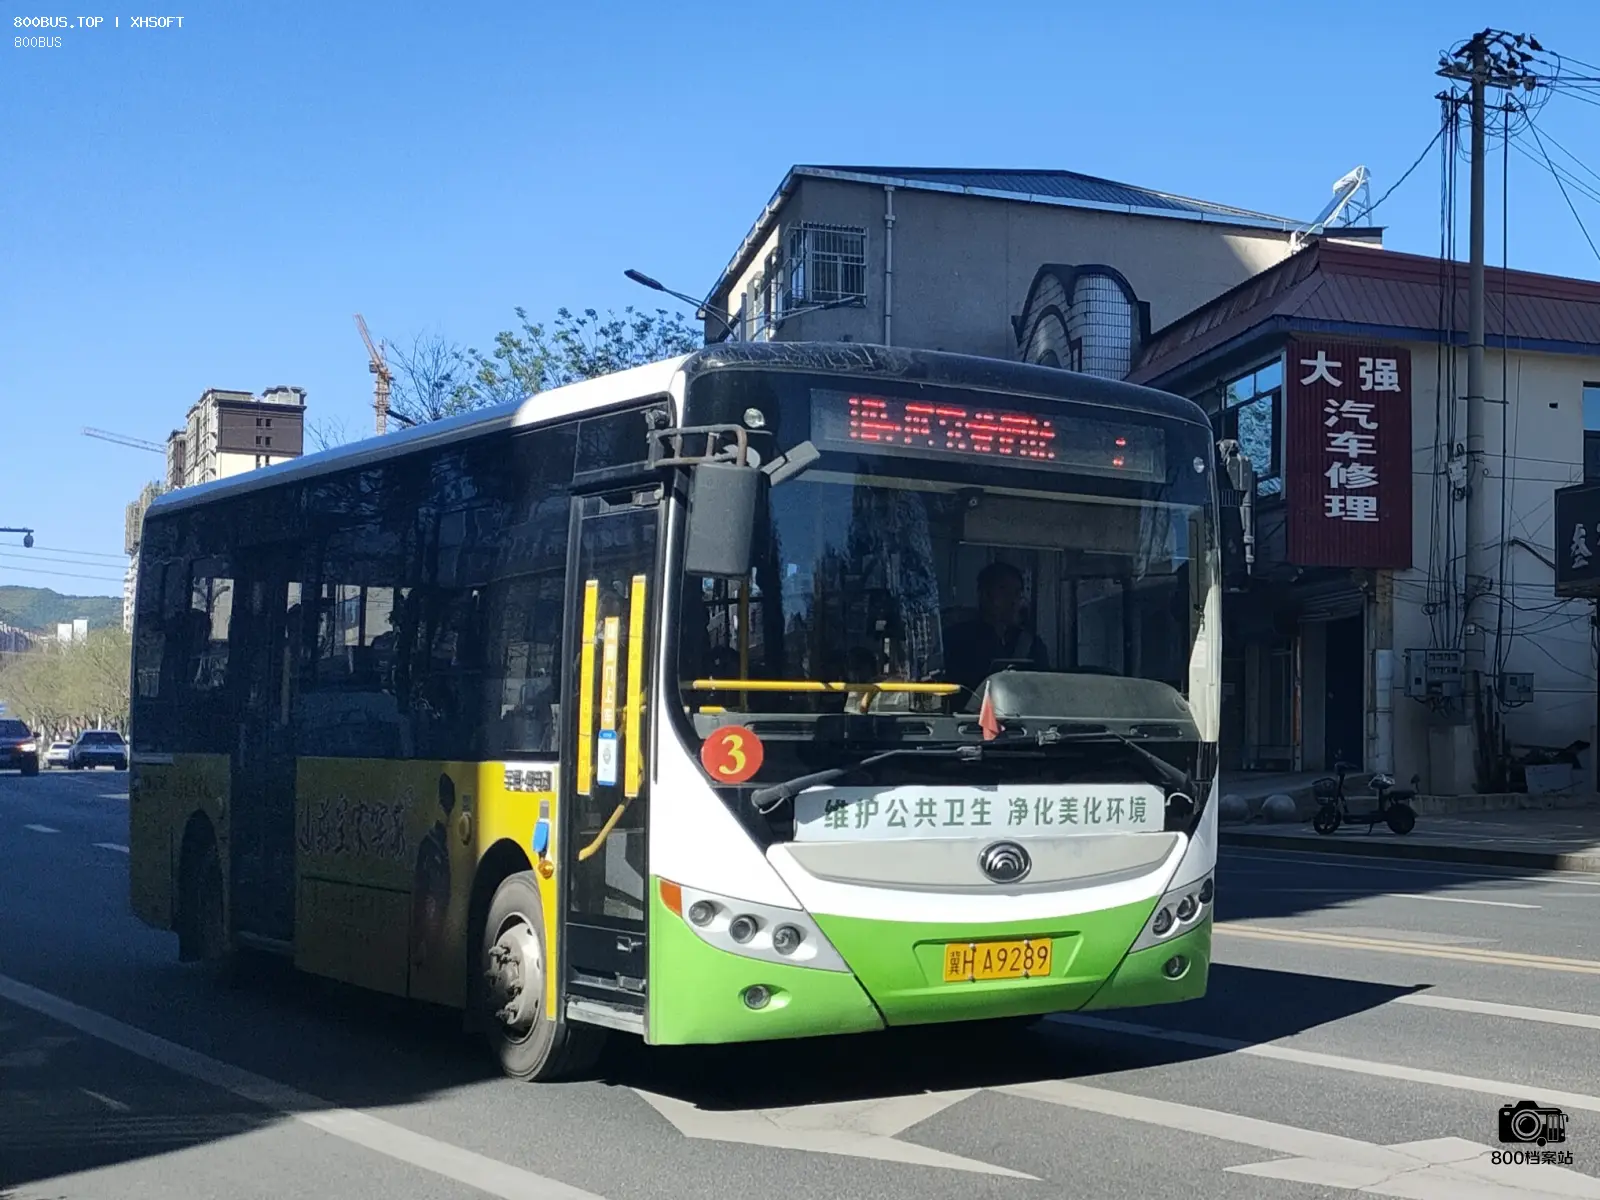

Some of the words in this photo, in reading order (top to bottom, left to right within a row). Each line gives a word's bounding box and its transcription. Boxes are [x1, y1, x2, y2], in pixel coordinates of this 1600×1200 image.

[1300, 350, 1401, 392] 大强
[1323, 399, 1379, 522] 汽车修理
[718, 734, 746, 775] 3
[824, 797, 993, 829] 维护公共卫生
[1006, 796, 1148, 827] 净化美化环境
